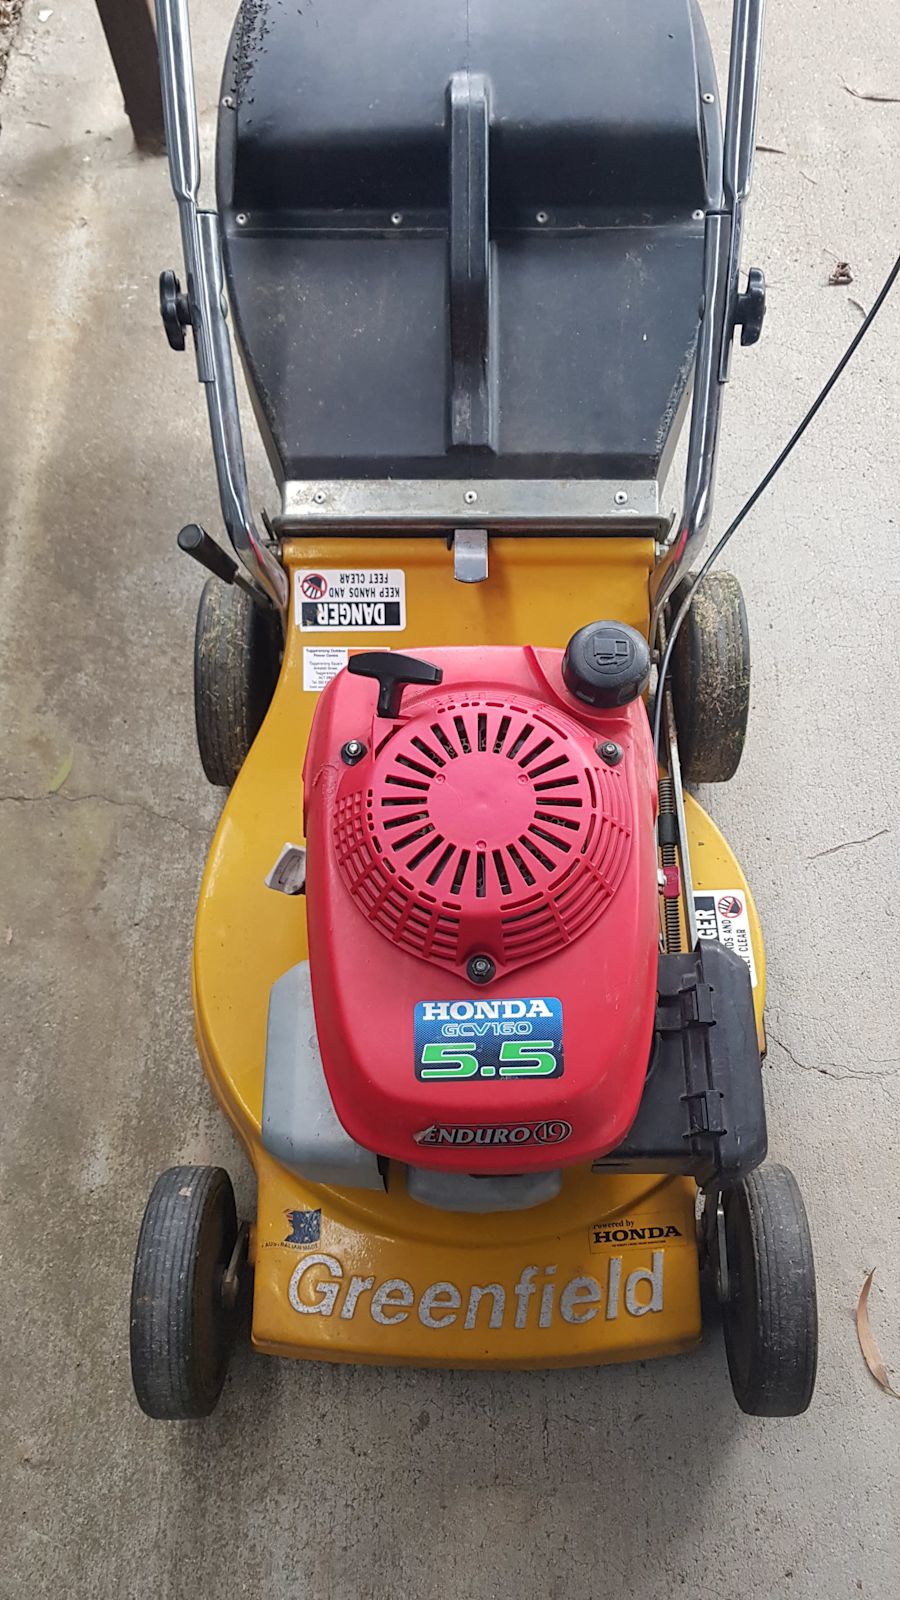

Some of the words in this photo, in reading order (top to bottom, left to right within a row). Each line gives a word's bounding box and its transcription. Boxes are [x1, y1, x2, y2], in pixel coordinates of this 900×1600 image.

[340, 573, 366, 584] CLEAR
[369, 573, 389, 584] FEET
[329, 587, 345, 598] AND
[349, 587, 375, 598] HANDS
[379, 587, 400, 598] KEEP
[317, 603, 386, 625] DANGER
[695, 909, 718, 940] GER
[721, 919, 732, 934] AND
[723, 937, 735, 952] NDS
[736, 929, 749, 952] CLEAR
[422, 999, 554, 1021] HONDA
[441, 1021, 533, 1037] GCV160
[421, 1040, 557, 1079] 5.5
[424, 1126, 531, 1144] ENDURO
[593, 1220, 624, 1229] Powered
[625, 1219, 635, 1228] by
[593, 1225, 682, 1244] HONDA
[287, 1249, 665, 1330] Greenfield
